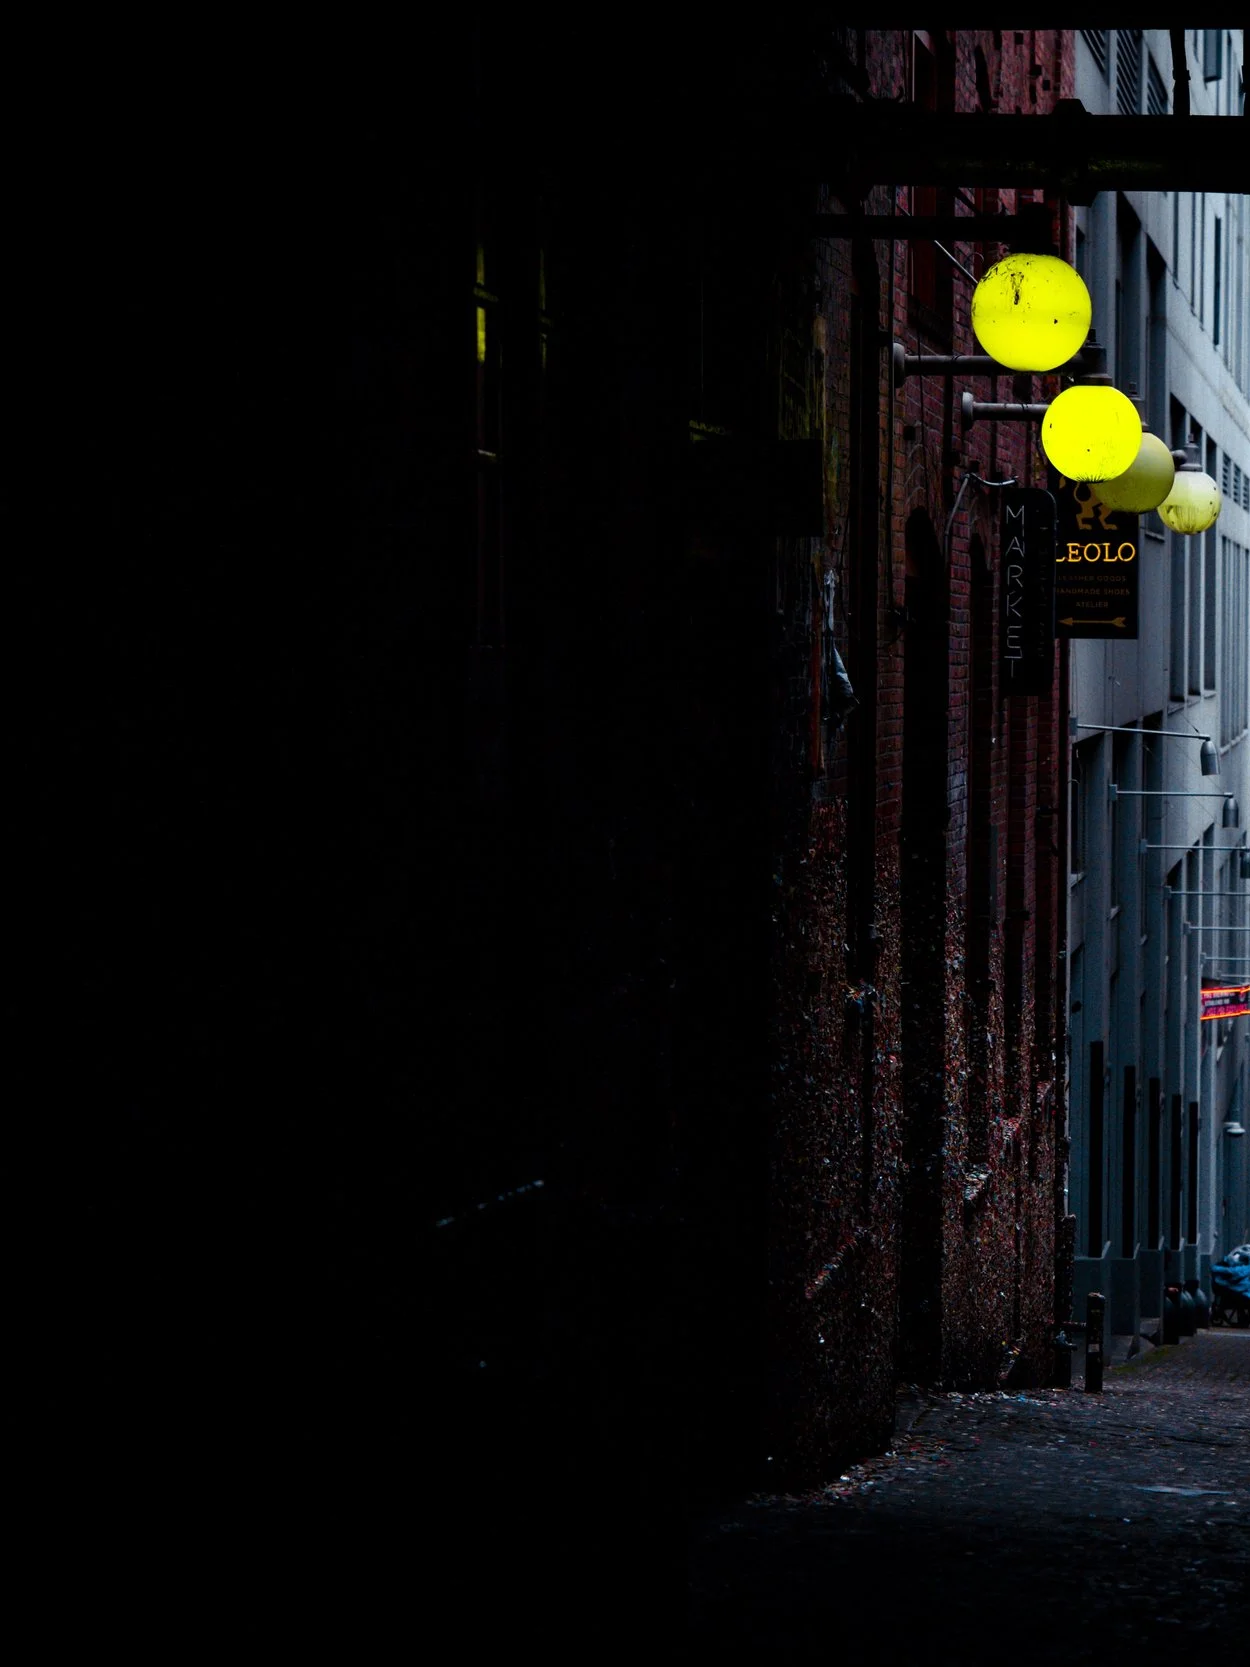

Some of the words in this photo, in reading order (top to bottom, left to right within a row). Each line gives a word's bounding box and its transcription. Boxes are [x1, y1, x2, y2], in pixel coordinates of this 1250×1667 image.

[1096, 575, 1128, 583] GOODS
[1004, 504, 1026, 679] MARKET
[1103, 587, 1131, 597] SHOES
[1075, 600, 1109, 609] ATELIER
